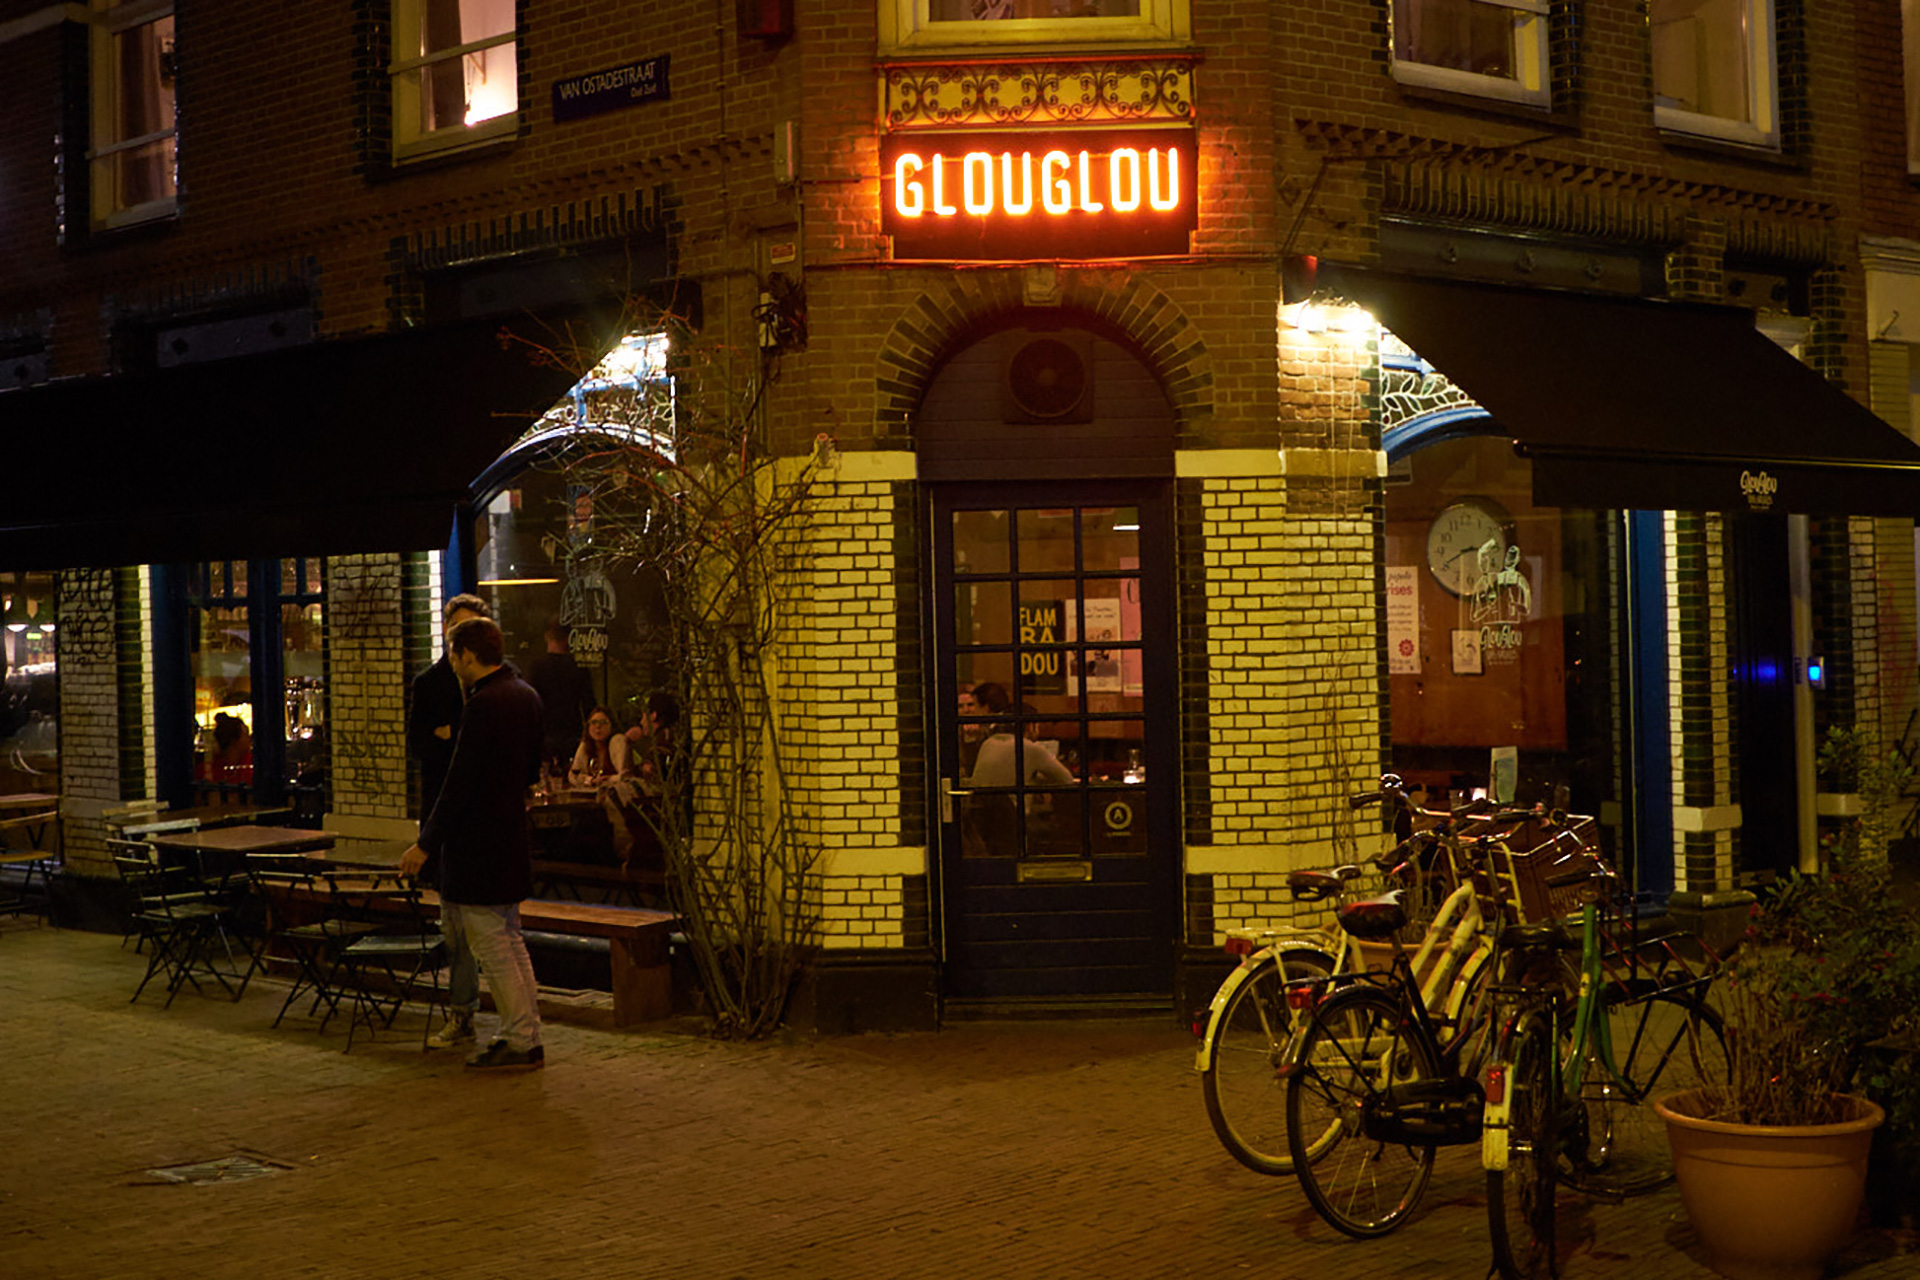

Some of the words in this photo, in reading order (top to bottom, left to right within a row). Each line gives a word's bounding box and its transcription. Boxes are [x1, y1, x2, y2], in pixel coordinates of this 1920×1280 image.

[559, 81, 580, 100] VAN
[582, 61, 656, 95] OSTADESTRAAT
[895, 147, 1180, 216] GLOUGLOU
[1019, 606, 1057, 627] FLAM
[1020, 651, 1059, 676] DOU
